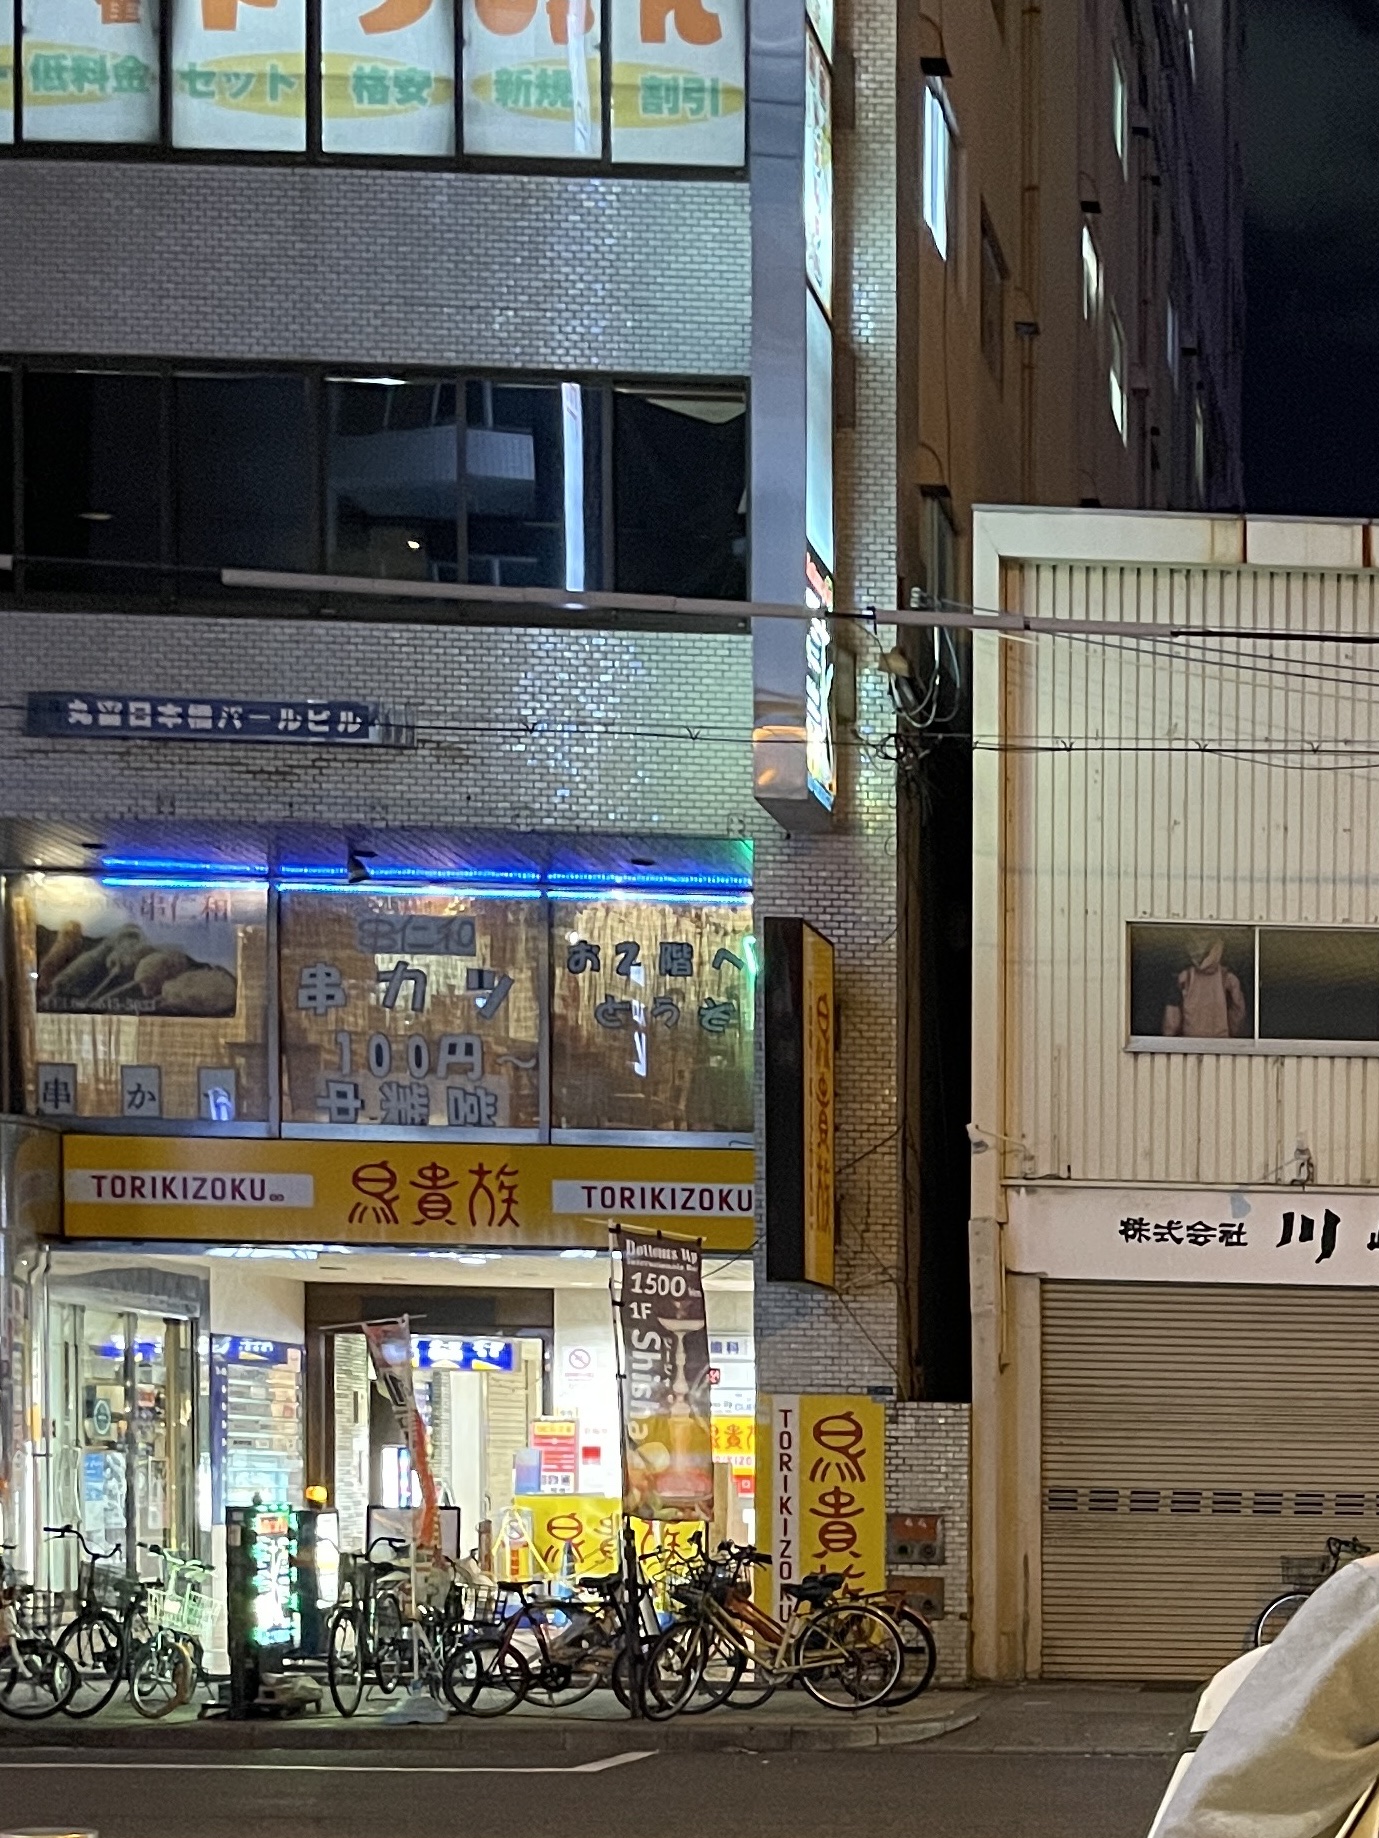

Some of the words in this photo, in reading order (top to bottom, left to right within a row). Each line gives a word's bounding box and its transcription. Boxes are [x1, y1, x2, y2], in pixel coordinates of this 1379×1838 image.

[30, 54, 150, 93] 低料金
[178, 62, 297, 102] セット
[352, 66, 433, 107] 格安
[640, 75, 720, 117] 割引
[298, 960, 515, 1020] 串カツ
[91, 1174, 266, 1202] TORIKIZOKU
[347, 1160, 521, 1228] 鳥貴族
[581, 1185, 753, 1212] TORIKIZOKU
[1119, 1216, 1249, 1248] 株式会社
[631, 1271, 687, 1298] 1500
[630, 1301, 652, 1320] 1F
[627, 1328, 662, 1442] Shisha
